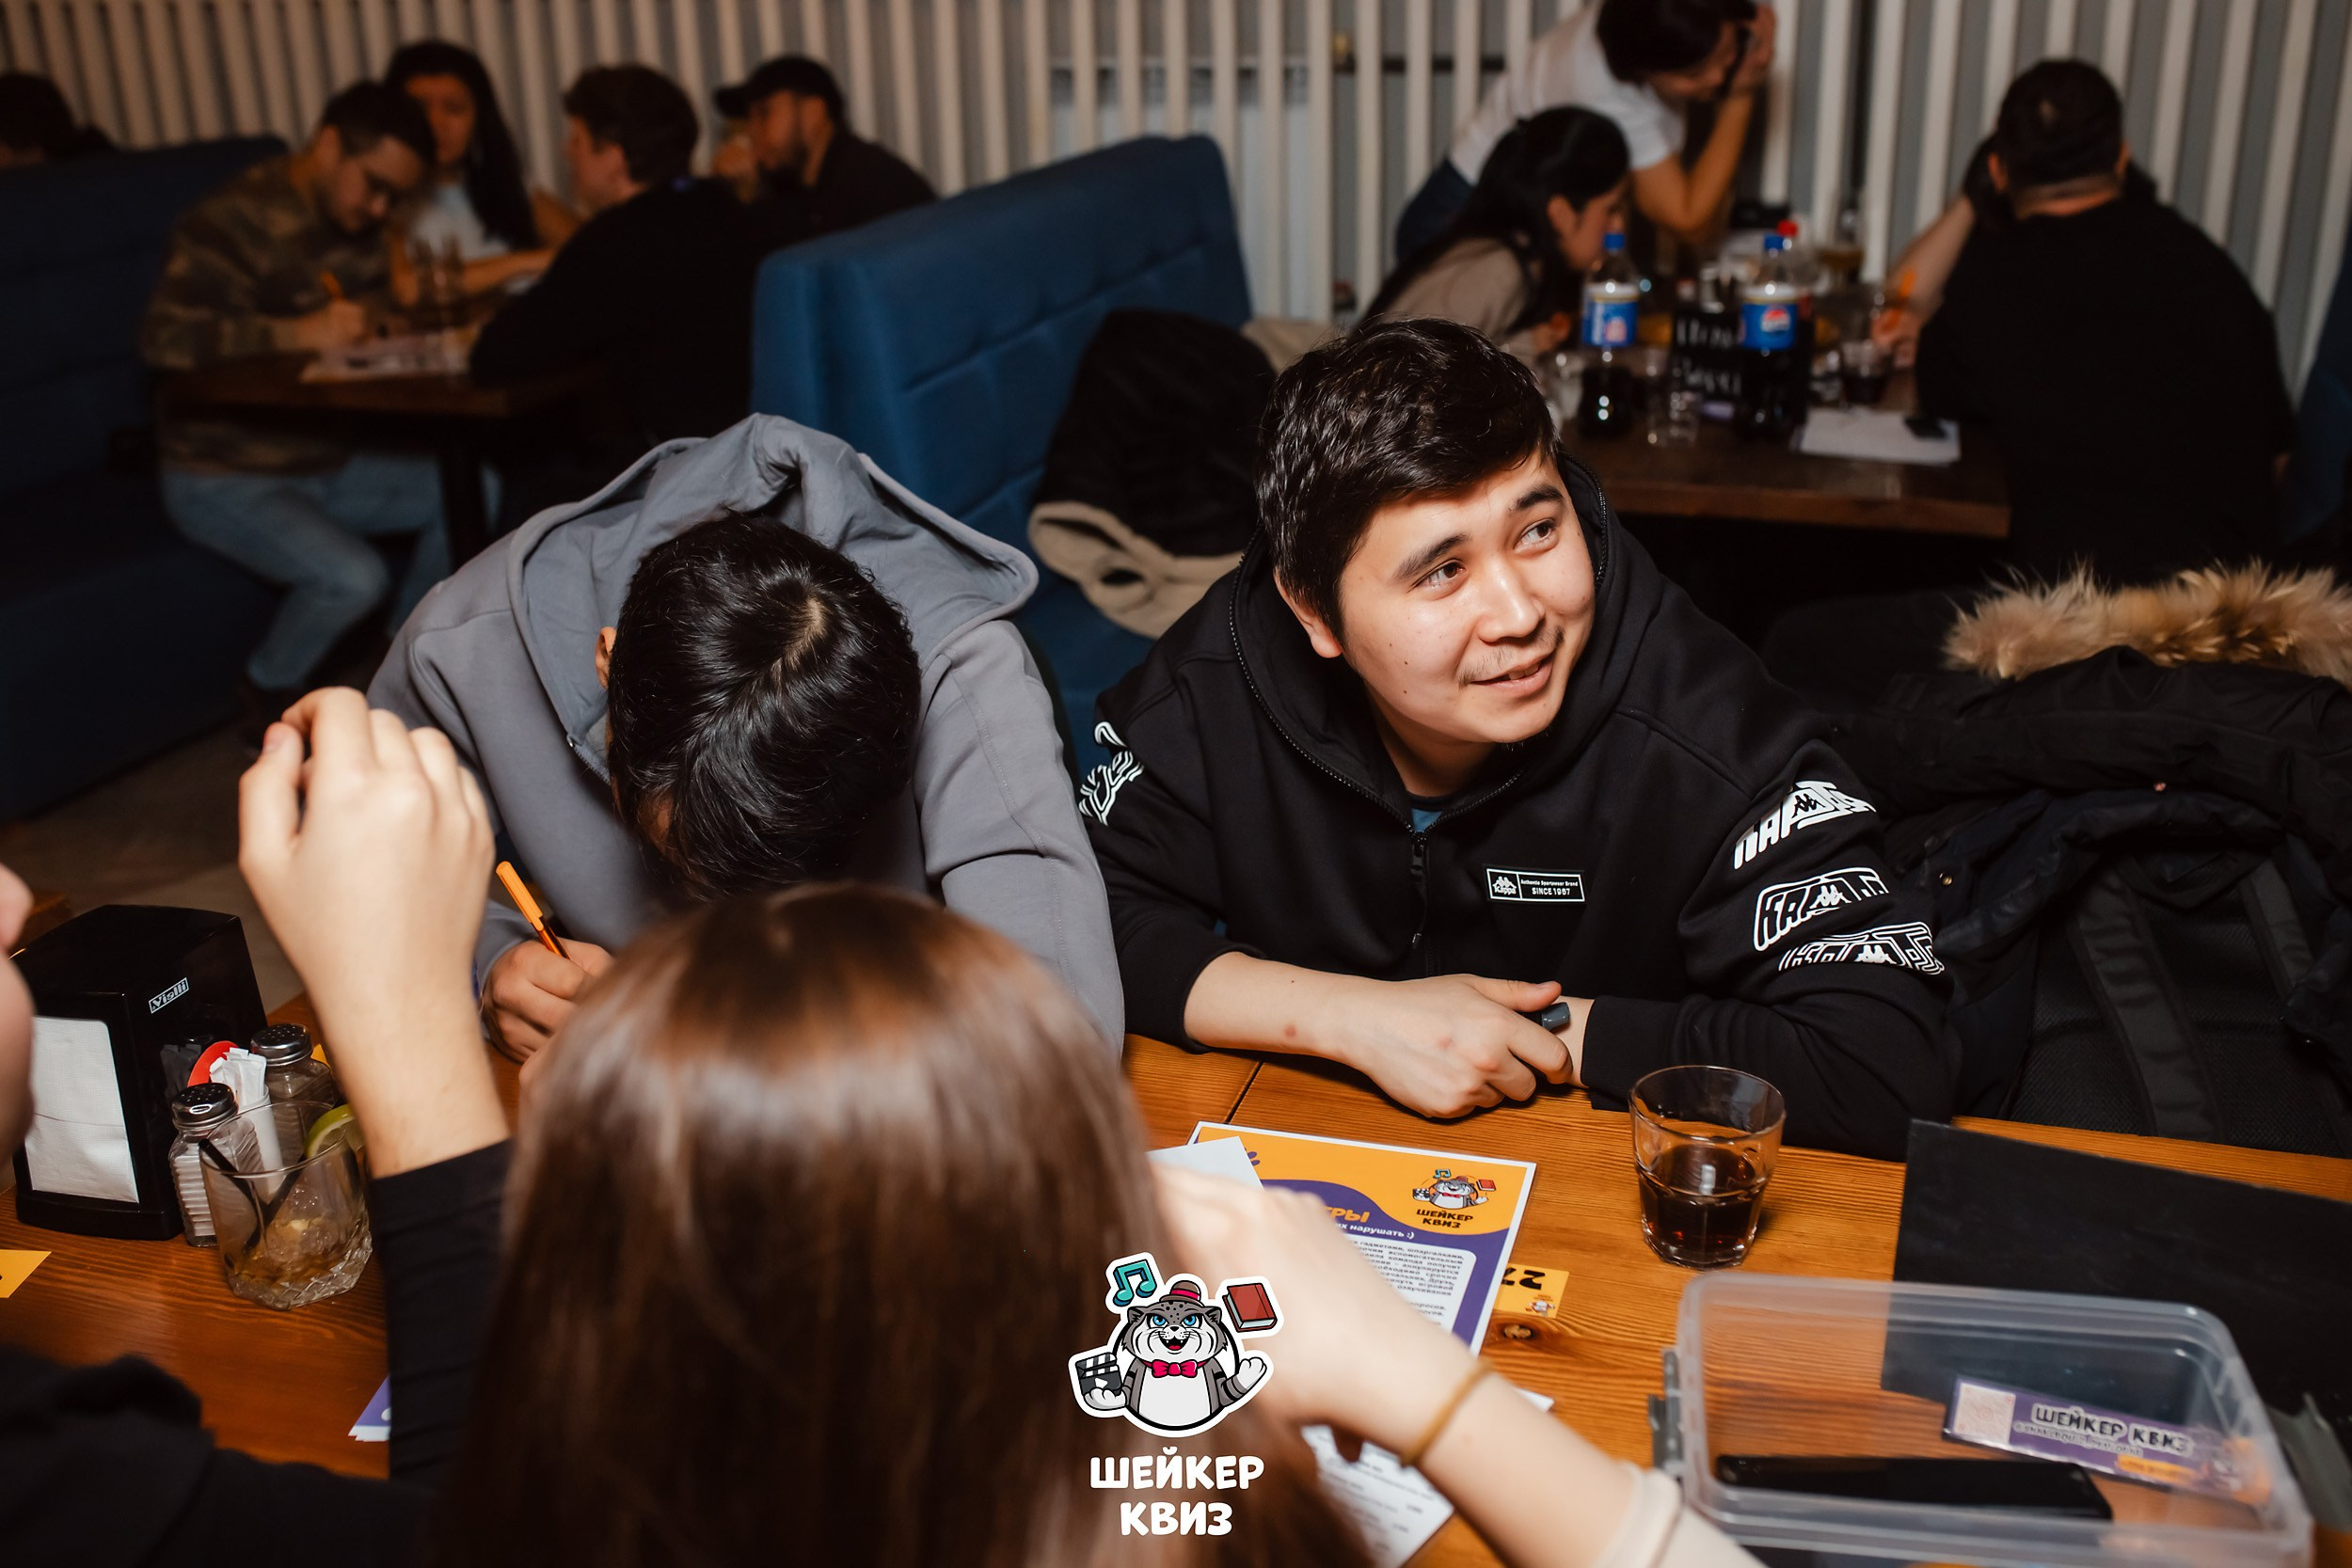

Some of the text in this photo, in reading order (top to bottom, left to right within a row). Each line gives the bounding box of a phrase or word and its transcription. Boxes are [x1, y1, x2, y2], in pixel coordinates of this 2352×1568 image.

[1532, 887, 1552, 895] SINCE
[152, 981, 186, 1007] Vialli
[1417, 1210, 1474, 1222] ШЕЙКЕР
[1422, 1218, 1461, 1228] КВИЗ
[1349, 1226, 1405, 1238] нарушать
[2035, 1405, 2123, 1438] ШЕЙКЕР
